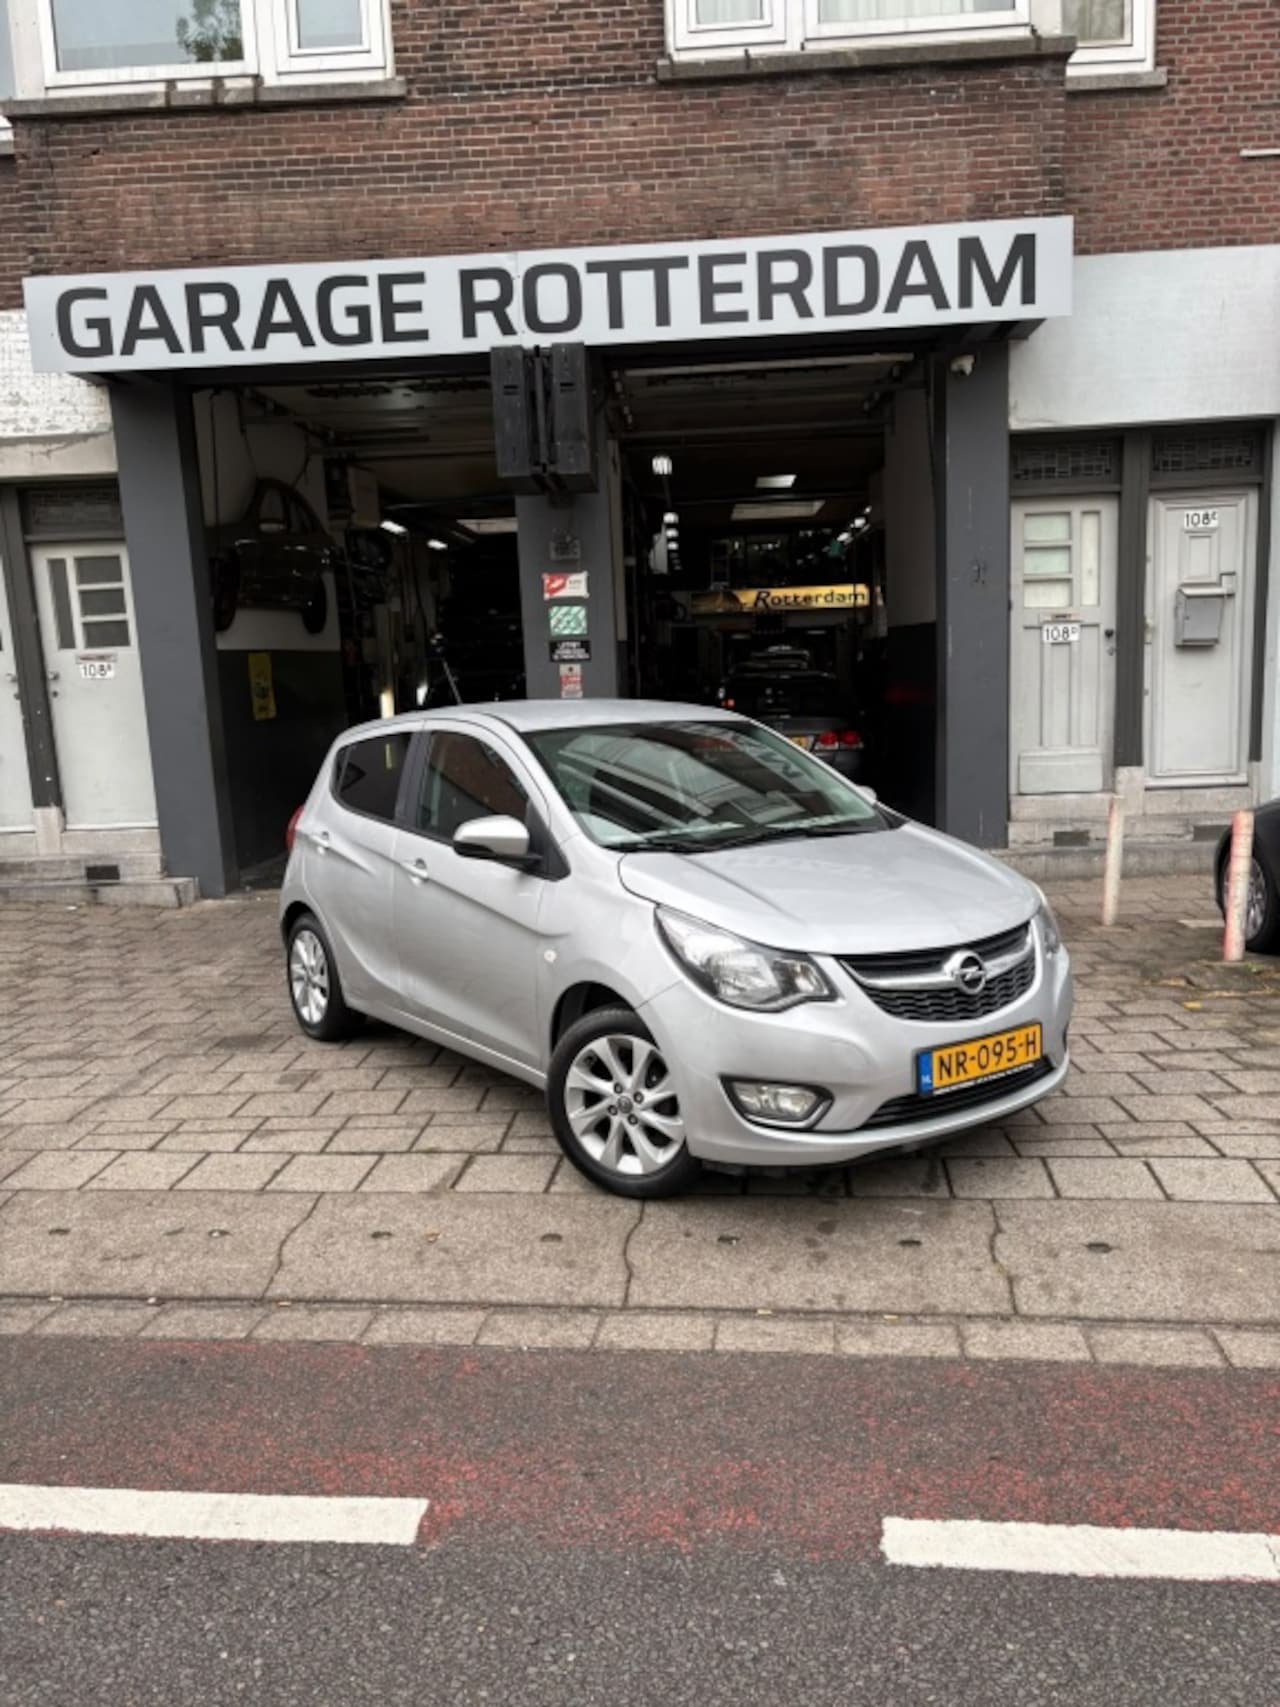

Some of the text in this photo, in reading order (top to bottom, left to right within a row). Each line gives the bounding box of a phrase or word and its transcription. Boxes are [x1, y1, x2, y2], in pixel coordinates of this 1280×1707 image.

[56, 232, 1036, 358] GARAGE ROTTERDAM
[755, 588, 866, 609] Rotterdam
[938, 1031, 1037, 1081] NR-095-H
